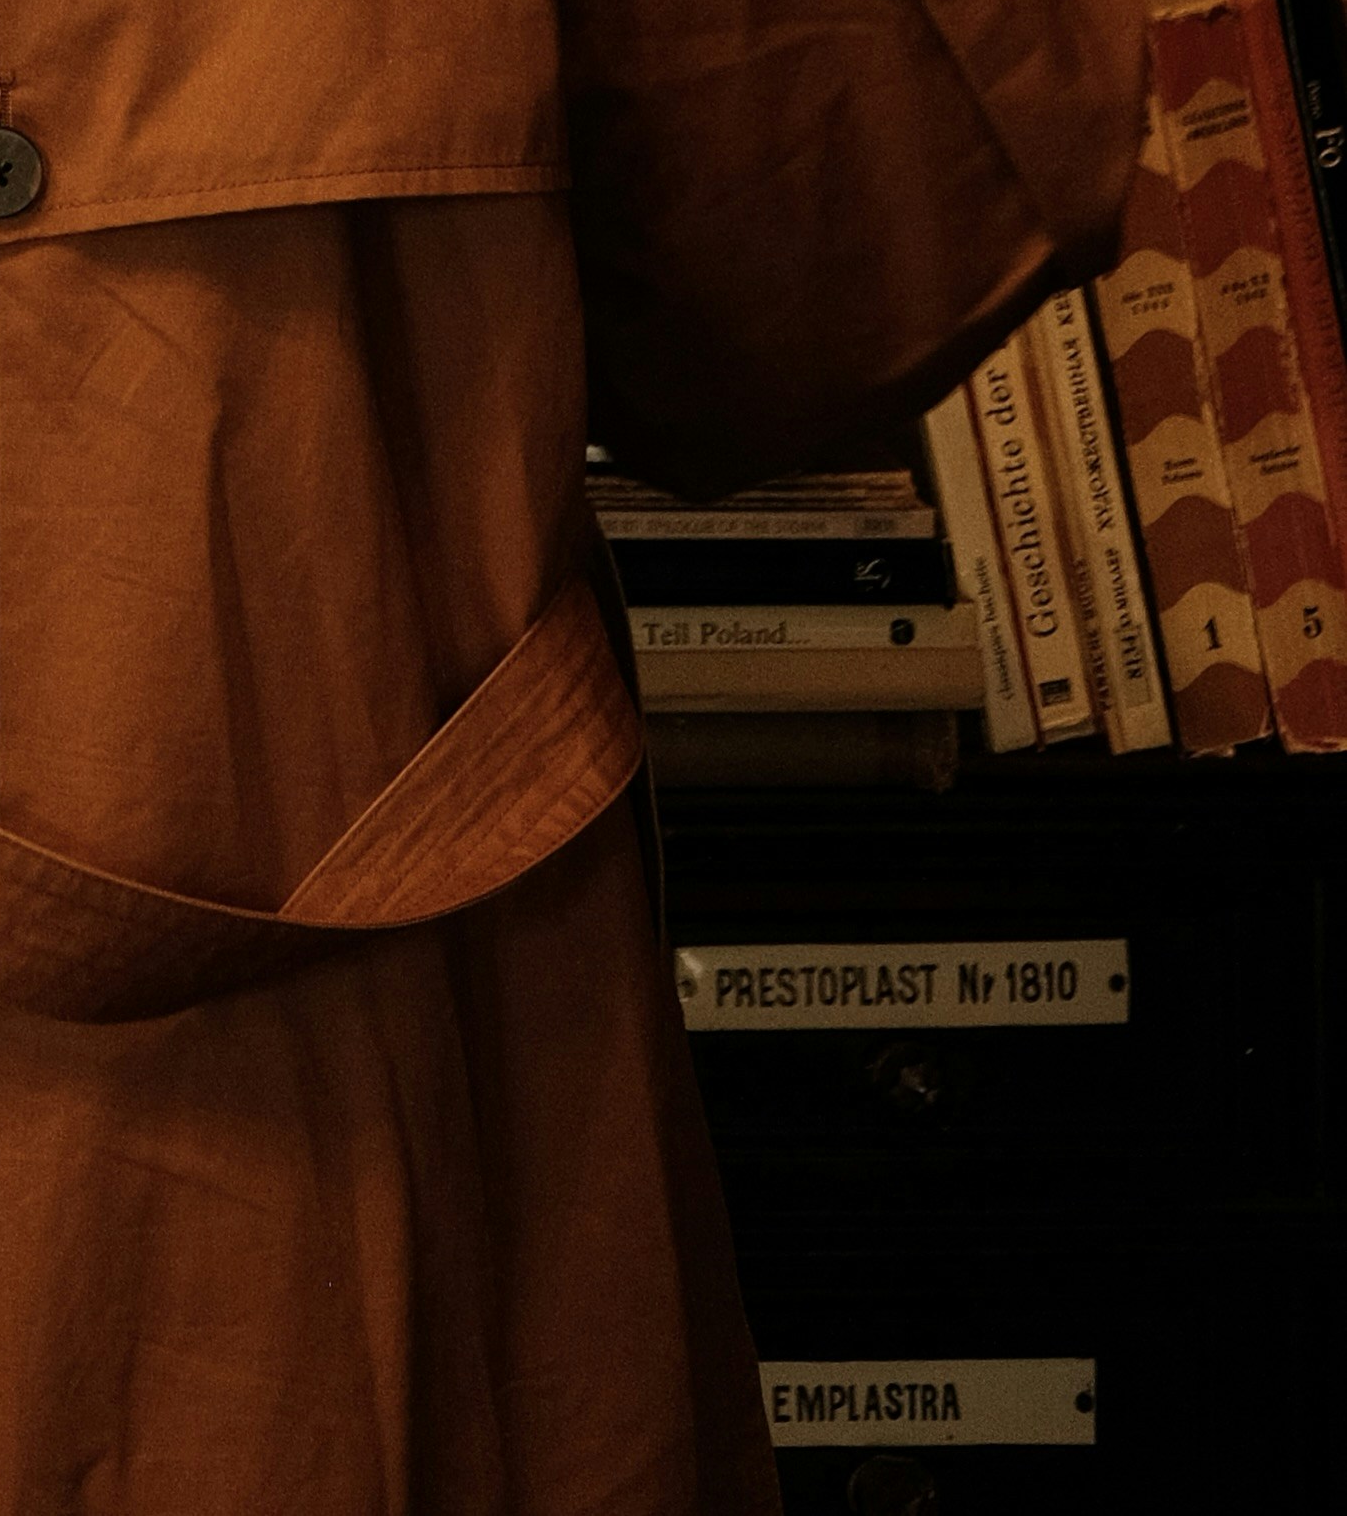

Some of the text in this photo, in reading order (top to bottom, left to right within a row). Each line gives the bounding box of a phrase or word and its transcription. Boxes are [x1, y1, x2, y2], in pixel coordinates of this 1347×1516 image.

[642, 621, 689, 647] Tell
[1203, 616, 1223, 651] 1
[1302, 605, 1323, 640] 5
[716, 961, 1078, 1007] PRESTOPLAST Nr 1810
[773, 1382, 961, 1423] EMPLASTRA
